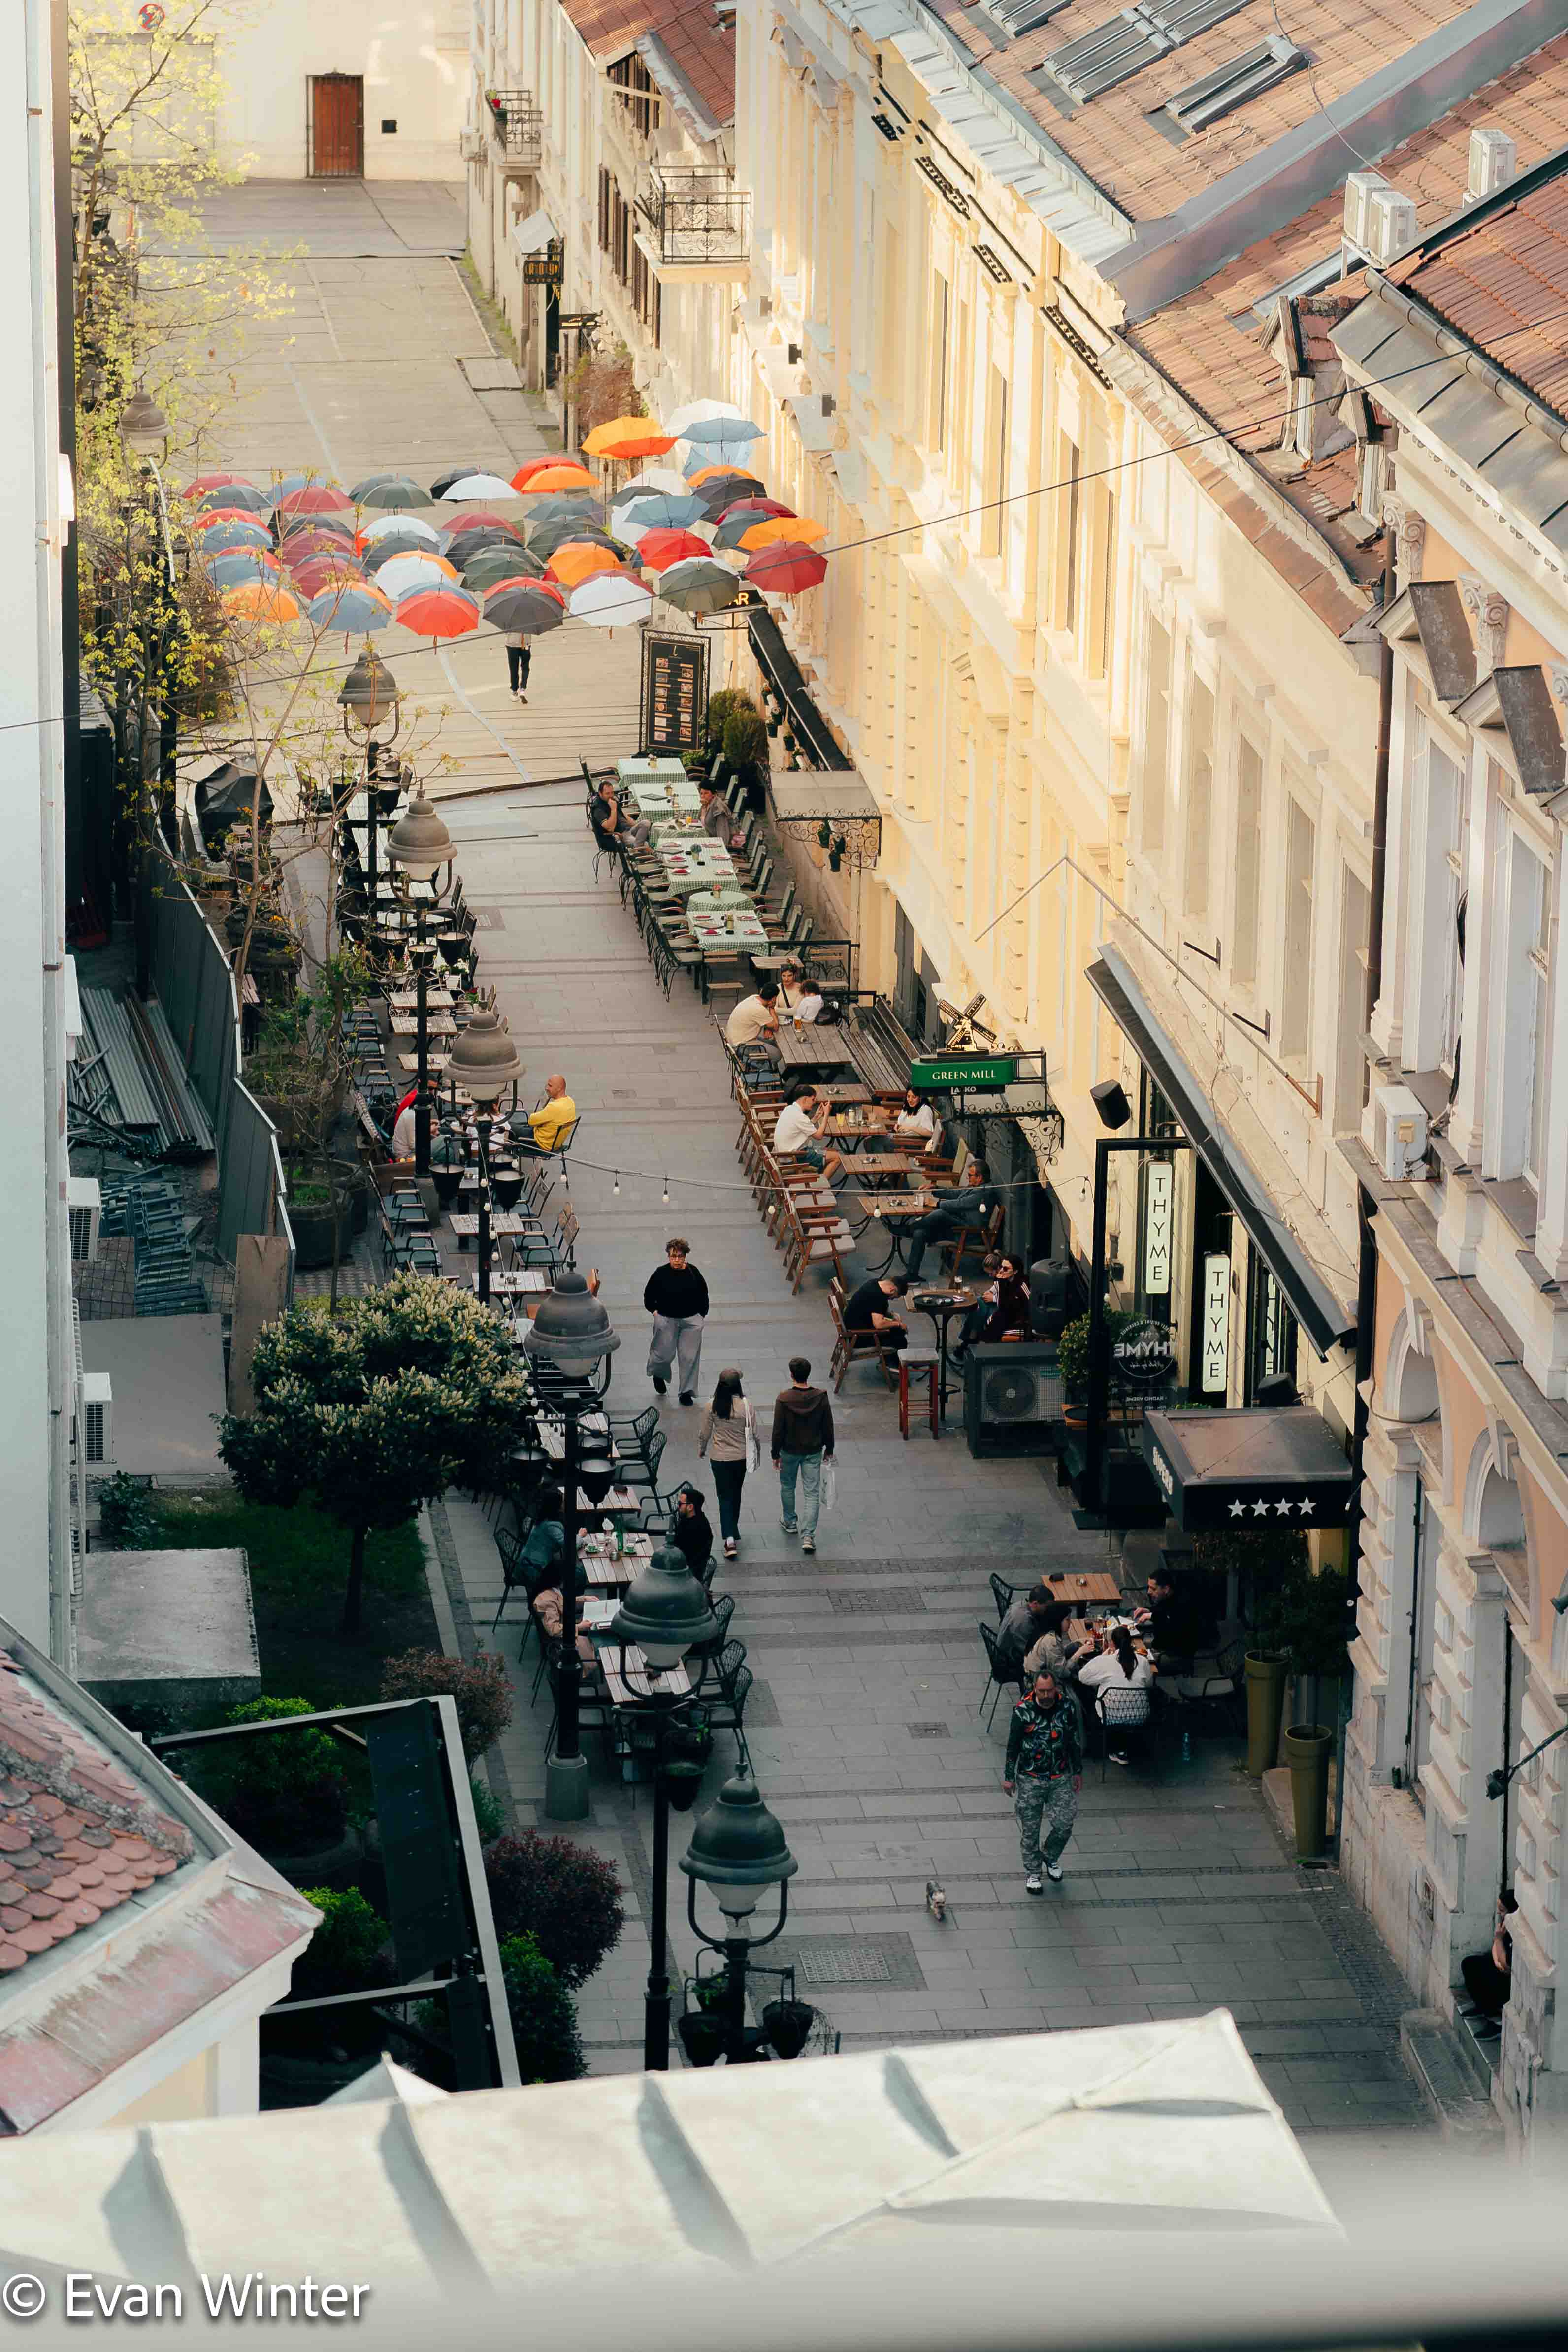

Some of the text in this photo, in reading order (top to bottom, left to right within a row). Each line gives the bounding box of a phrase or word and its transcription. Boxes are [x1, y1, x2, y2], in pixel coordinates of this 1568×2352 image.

[932, 1069, 997, 1080] GREEN MILL
[950, 1086, 977, 1095] LAKO
[1149, 1177, 1167, 1280] THYME
[1206, 1271, 1225, 1378] THYME
